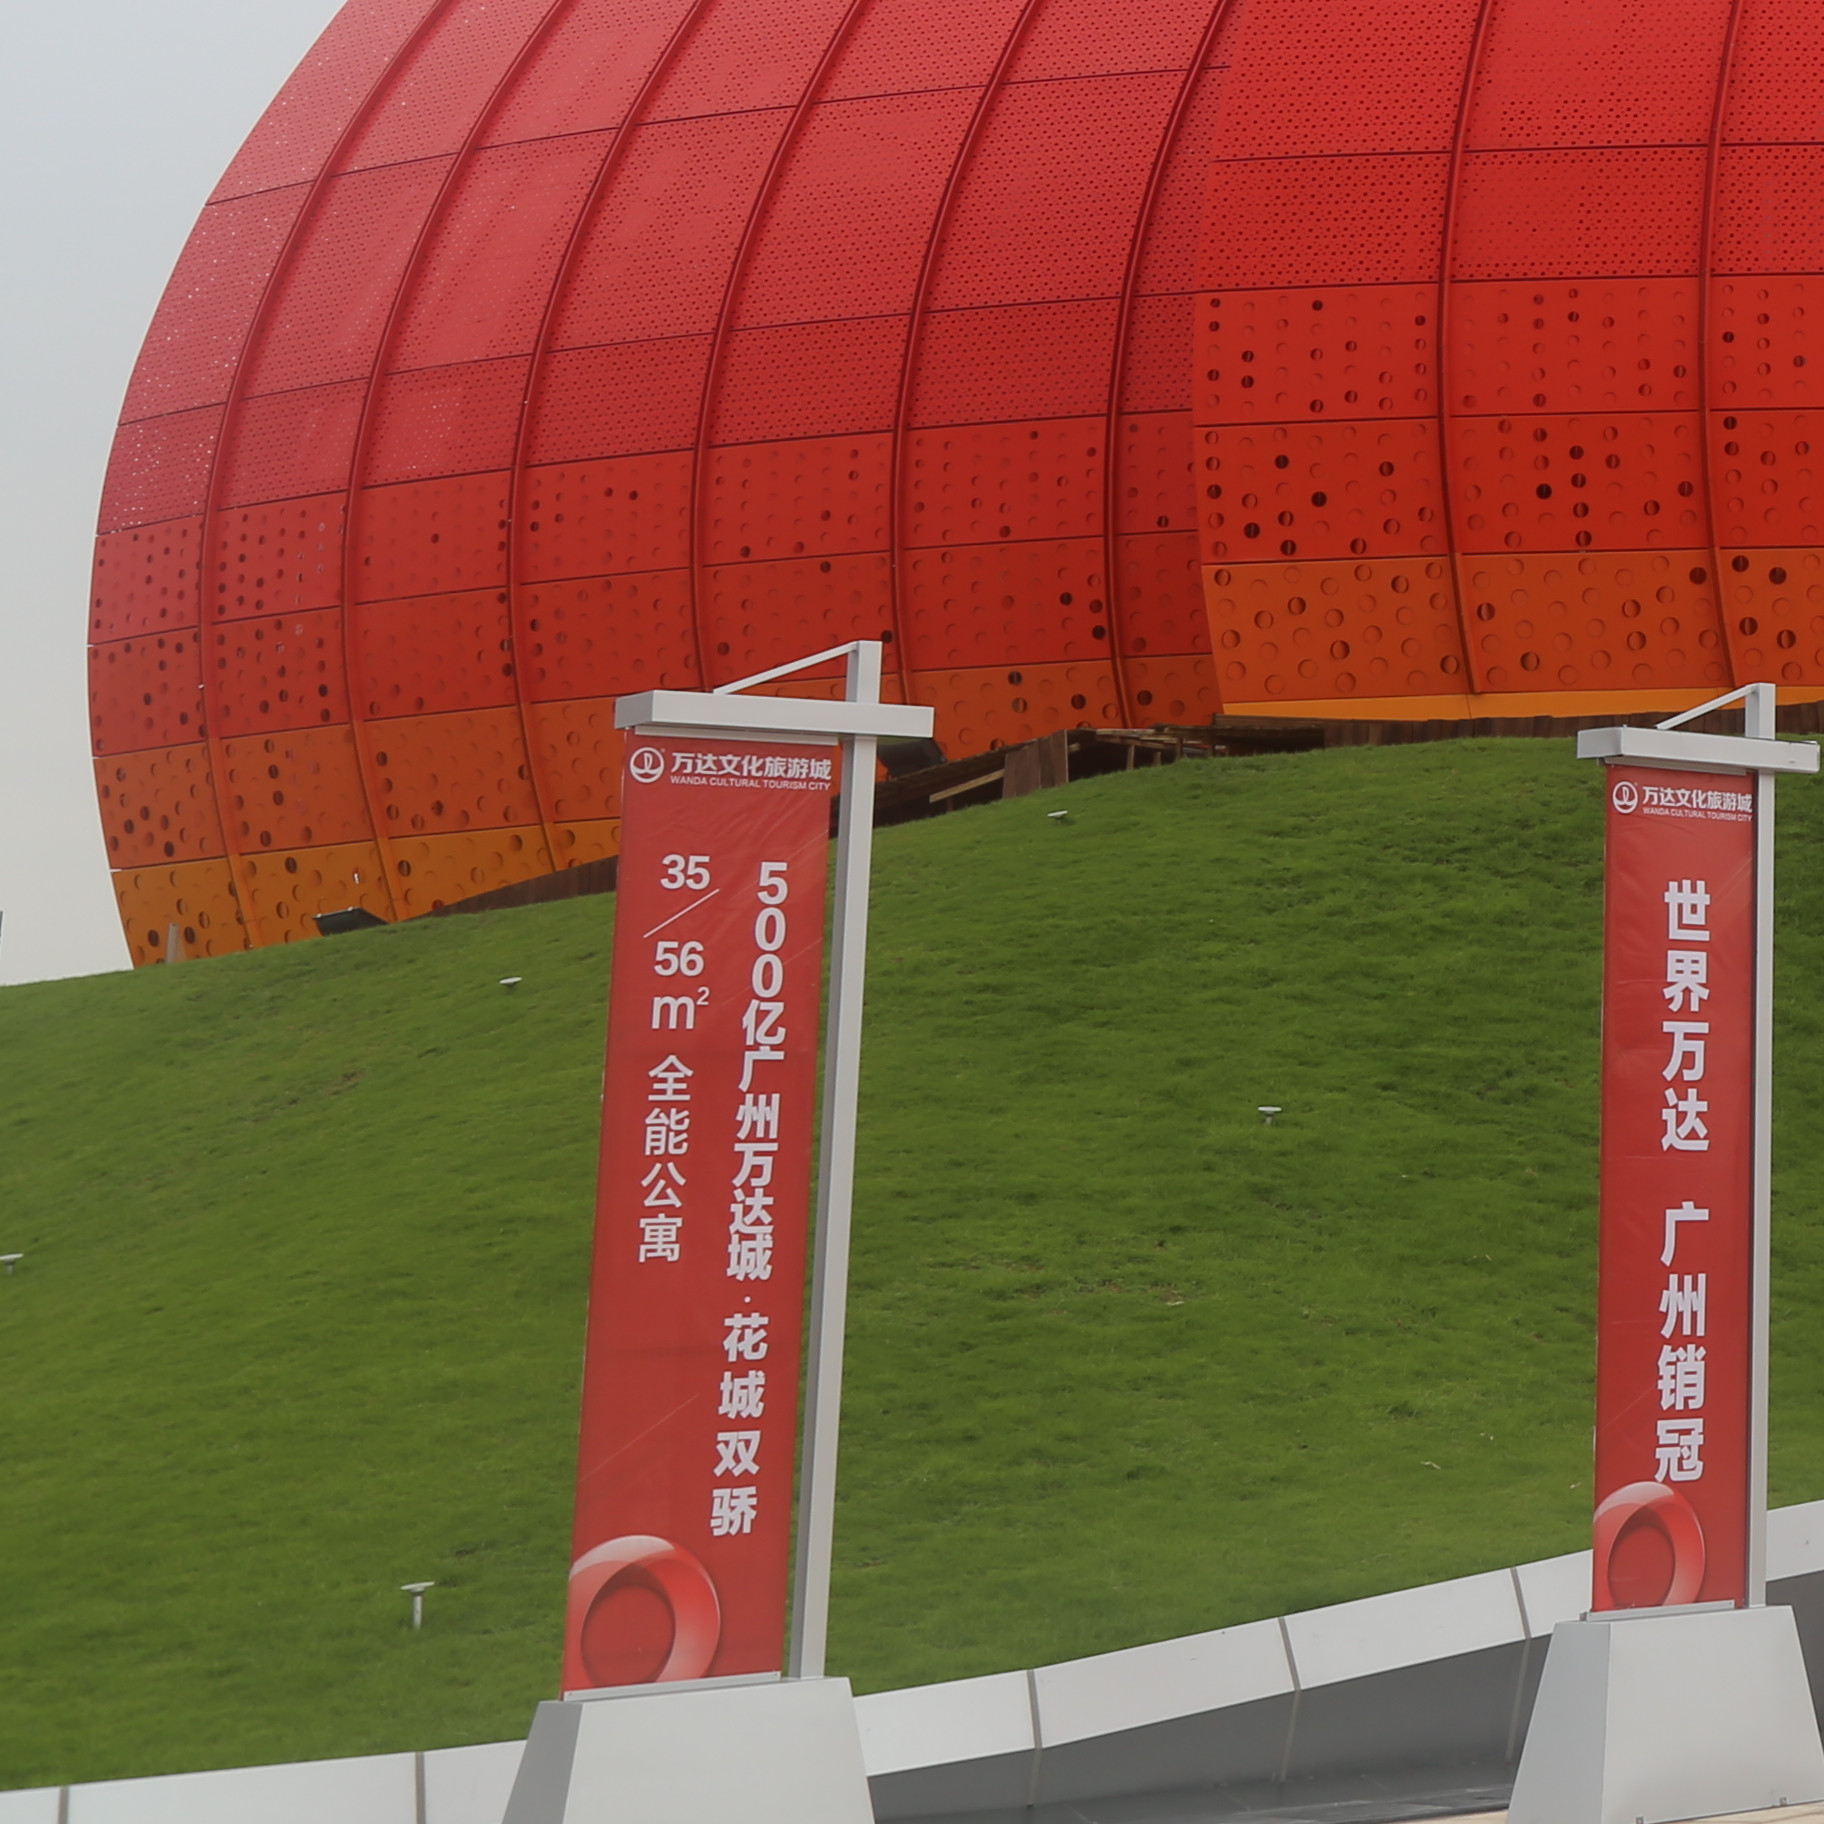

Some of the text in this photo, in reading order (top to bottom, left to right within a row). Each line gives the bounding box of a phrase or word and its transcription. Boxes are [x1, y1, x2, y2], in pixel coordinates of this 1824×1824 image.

[671, 752, 832, 780] 万达文化旅游城
[671, 776, 832, 791] WANDA CULTURAL TOURISM CITY
[1642, 785, 1752, 813] 万达文化旅游城
[1671, 809, 1706, 818] CULTURAL
[1707, 811, 1737, 821] TOURISM
[1737, 813, 1752, 822] CITY
[636, 1053, 694, 1265] 全能公寓
[1654, 879, 1711, 1485] 世界万达 广州销冠
